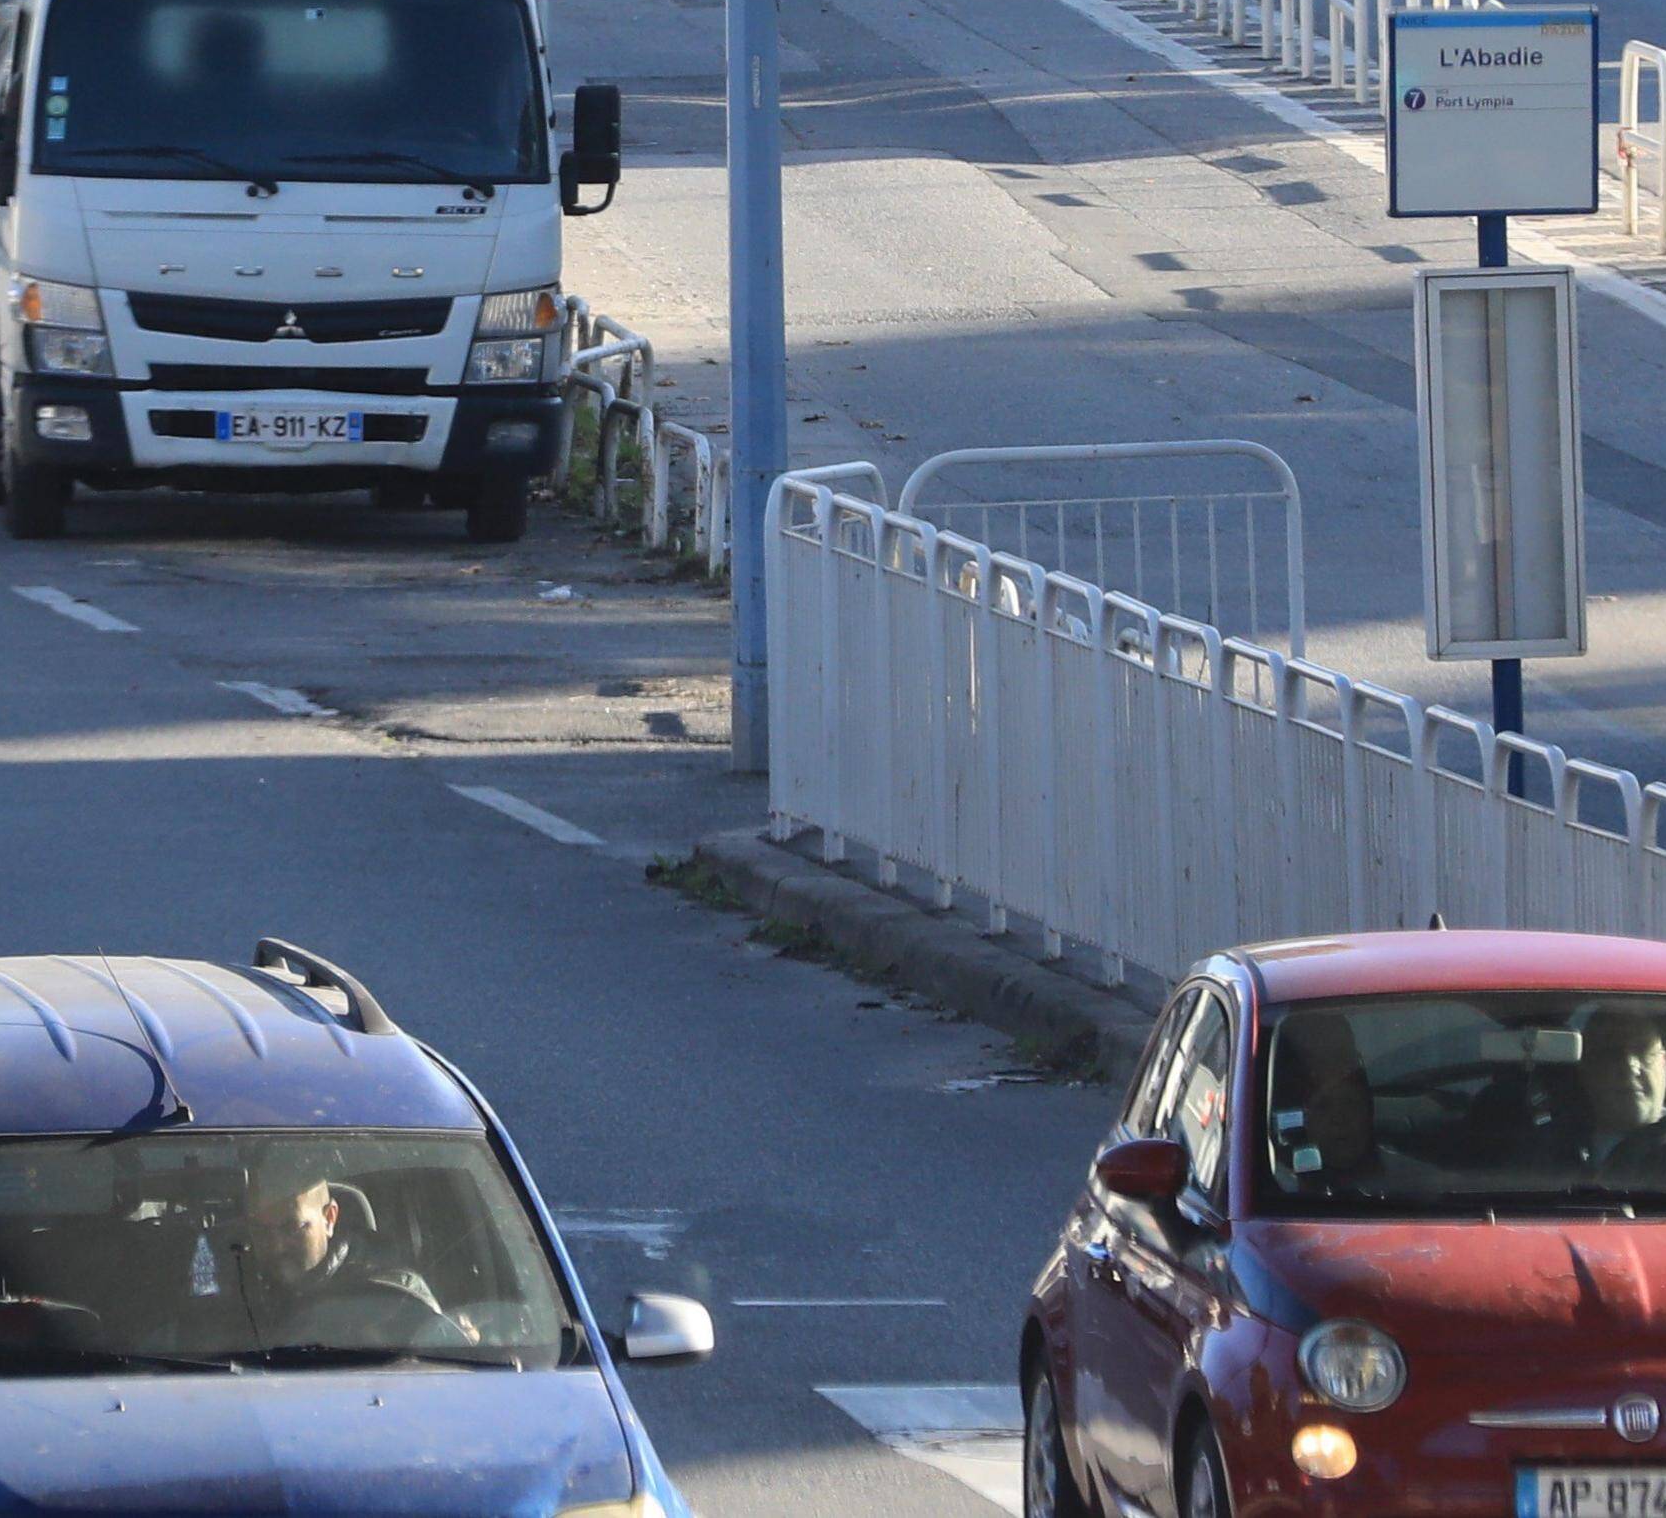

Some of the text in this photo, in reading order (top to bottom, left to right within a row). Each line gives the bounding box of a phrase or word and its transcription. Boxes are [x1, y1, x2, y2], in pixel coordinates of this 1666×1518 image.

[1440, 47, 1543, 67] L'Abadie
[1436, 96, 1463, 107] Port
[1466, 95, 1514, 110] Lympia
[232, 415, 347, 438] EA-911-KZ
